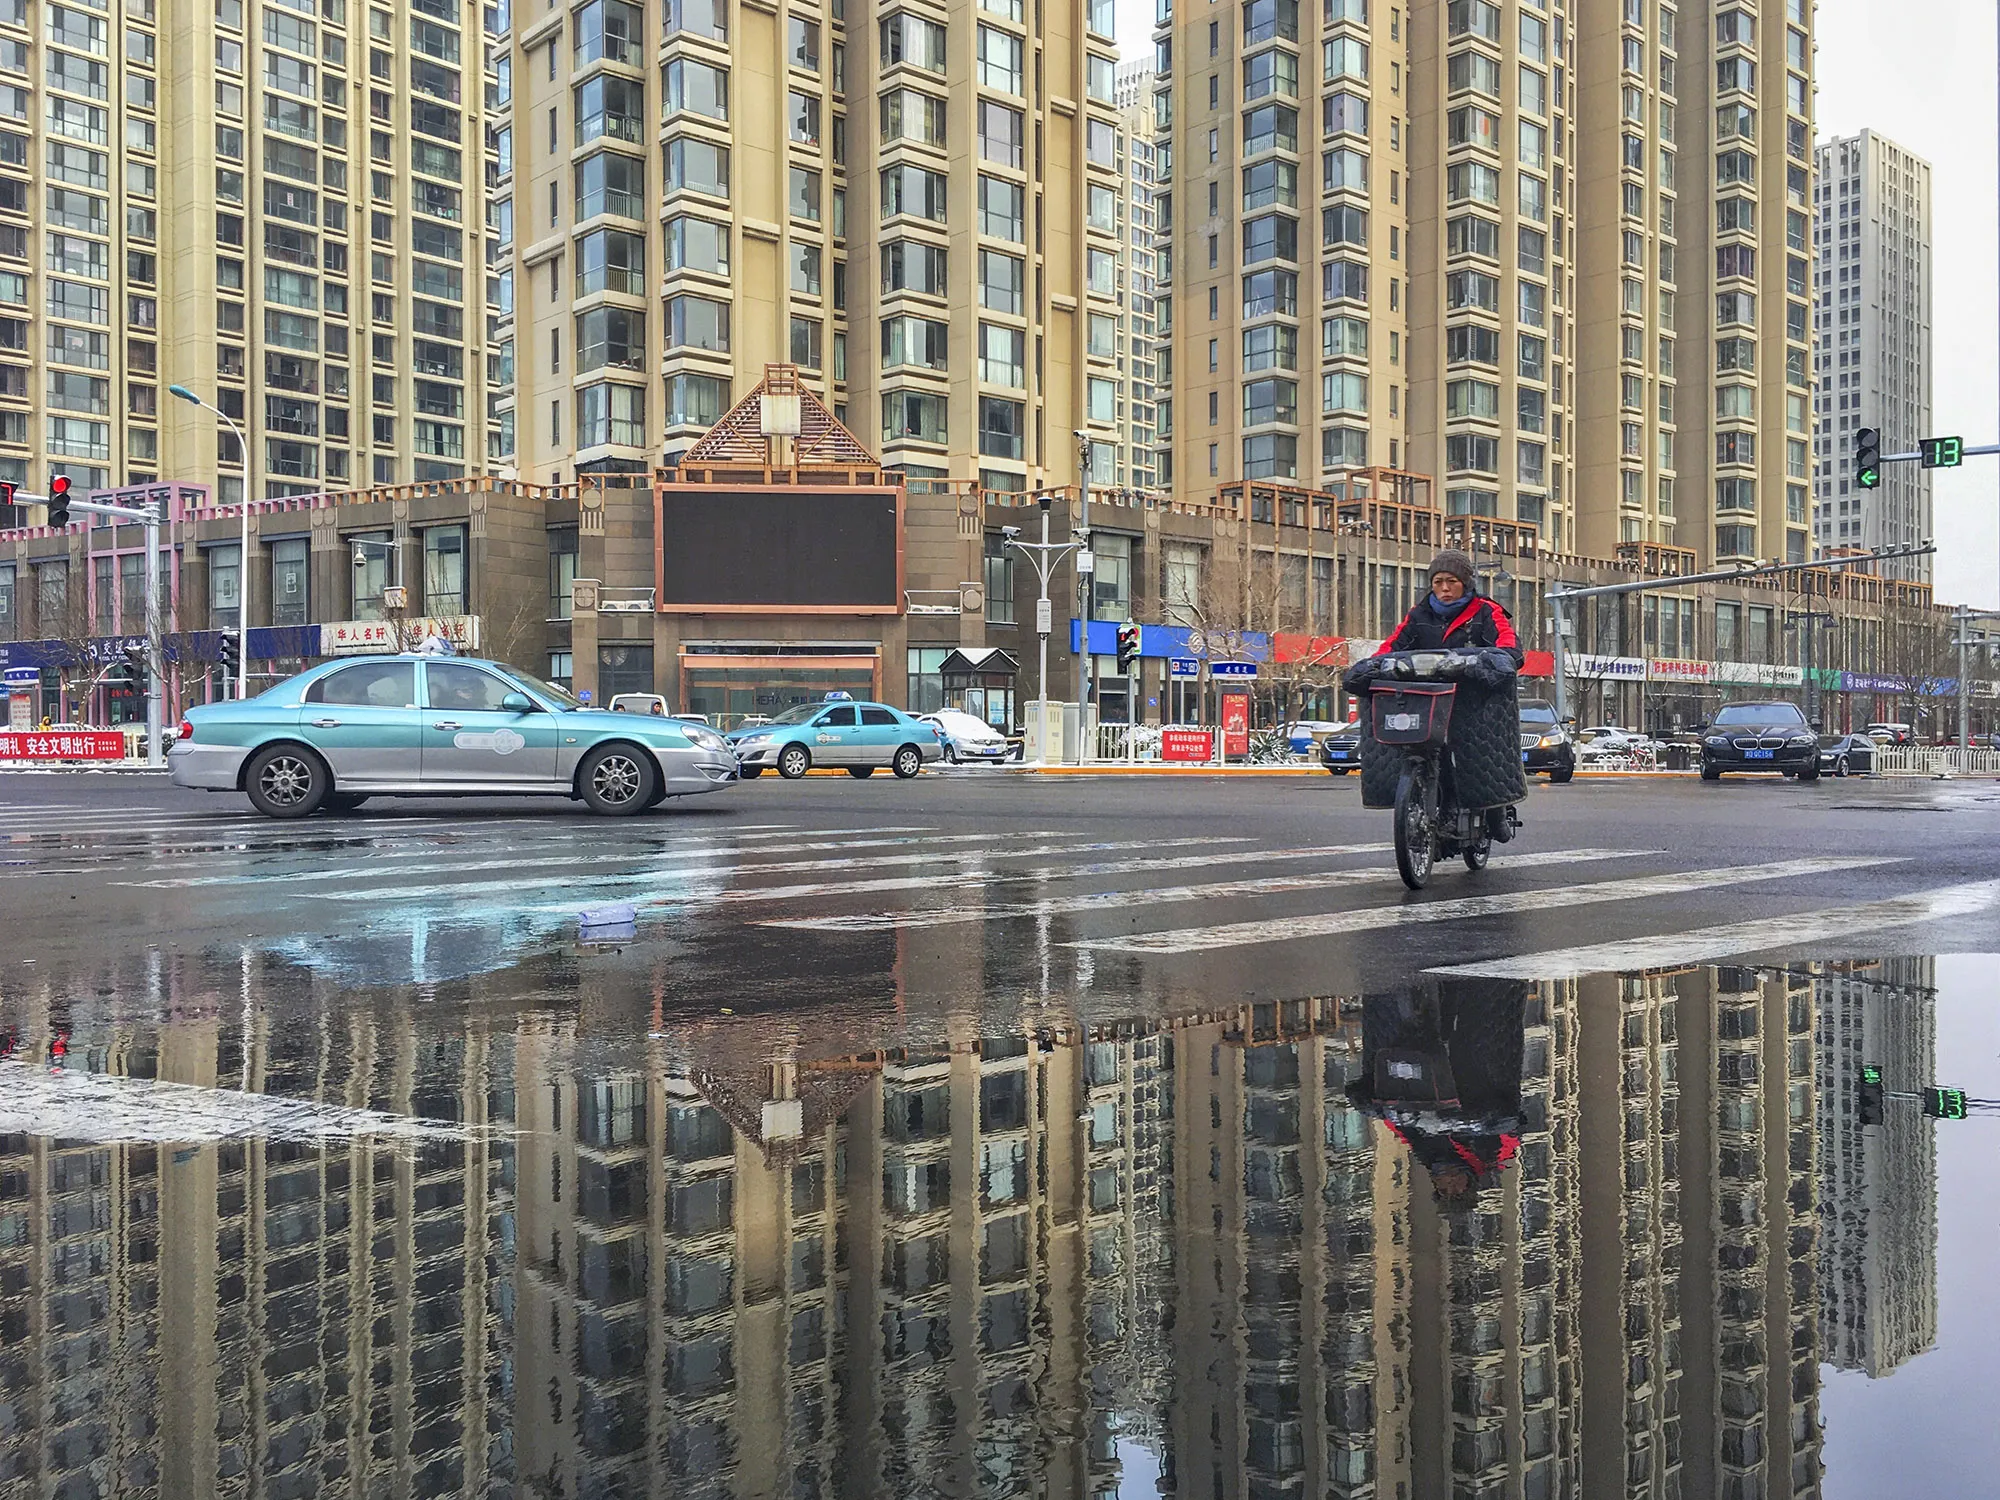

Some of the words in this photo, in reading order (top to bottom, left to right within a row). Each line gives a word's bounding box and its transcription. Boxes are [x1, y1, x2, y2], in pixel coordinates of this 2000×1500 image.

[1935, 439, 1959, 465] 13
[337, 627, 385, 641] 华人名轩
[413, 623, 464, 638] 华人名轩
[0, 737, 21, 755] 明礼
[26, 736, 96, 755] 安全文明出行
